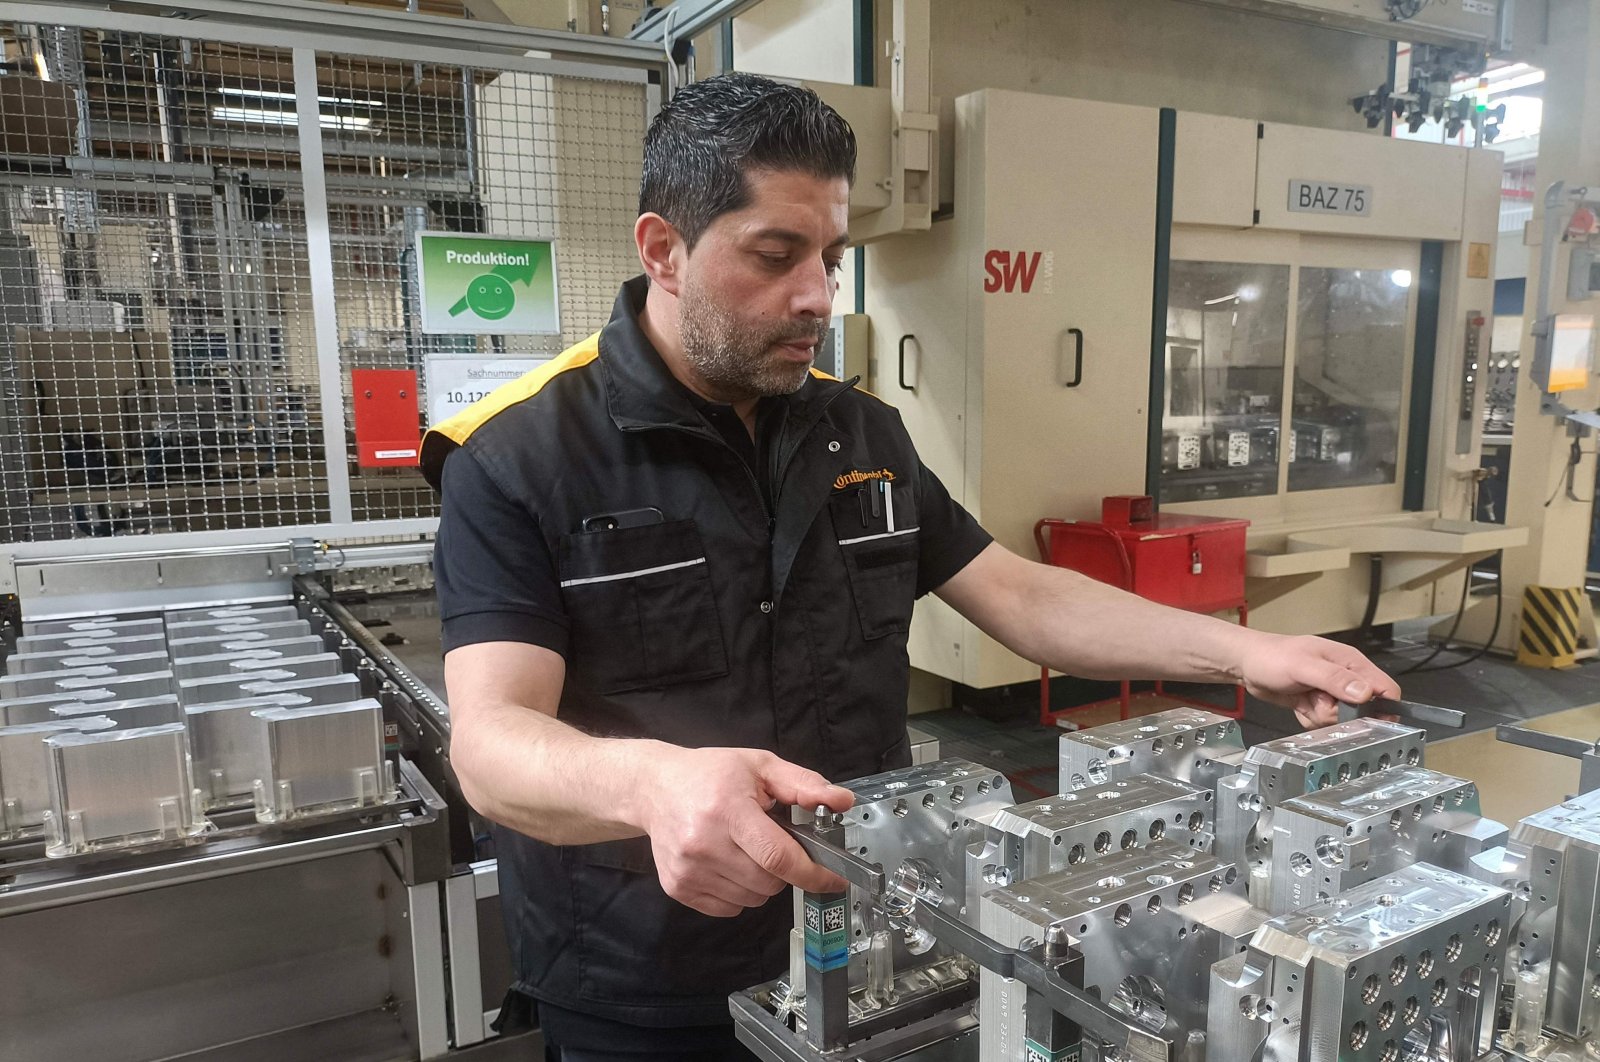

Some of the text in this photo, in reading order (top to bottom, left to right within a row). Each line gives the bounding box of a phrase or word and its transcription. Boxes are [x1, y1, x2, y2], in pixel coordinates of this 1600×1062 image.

[1299, 184, 1365, 212] BAZ 75
[446, 250, 529, 266] Produktion!
[984, 249, 1042, 293] SW
[833, 470, 882, 489] Continental
